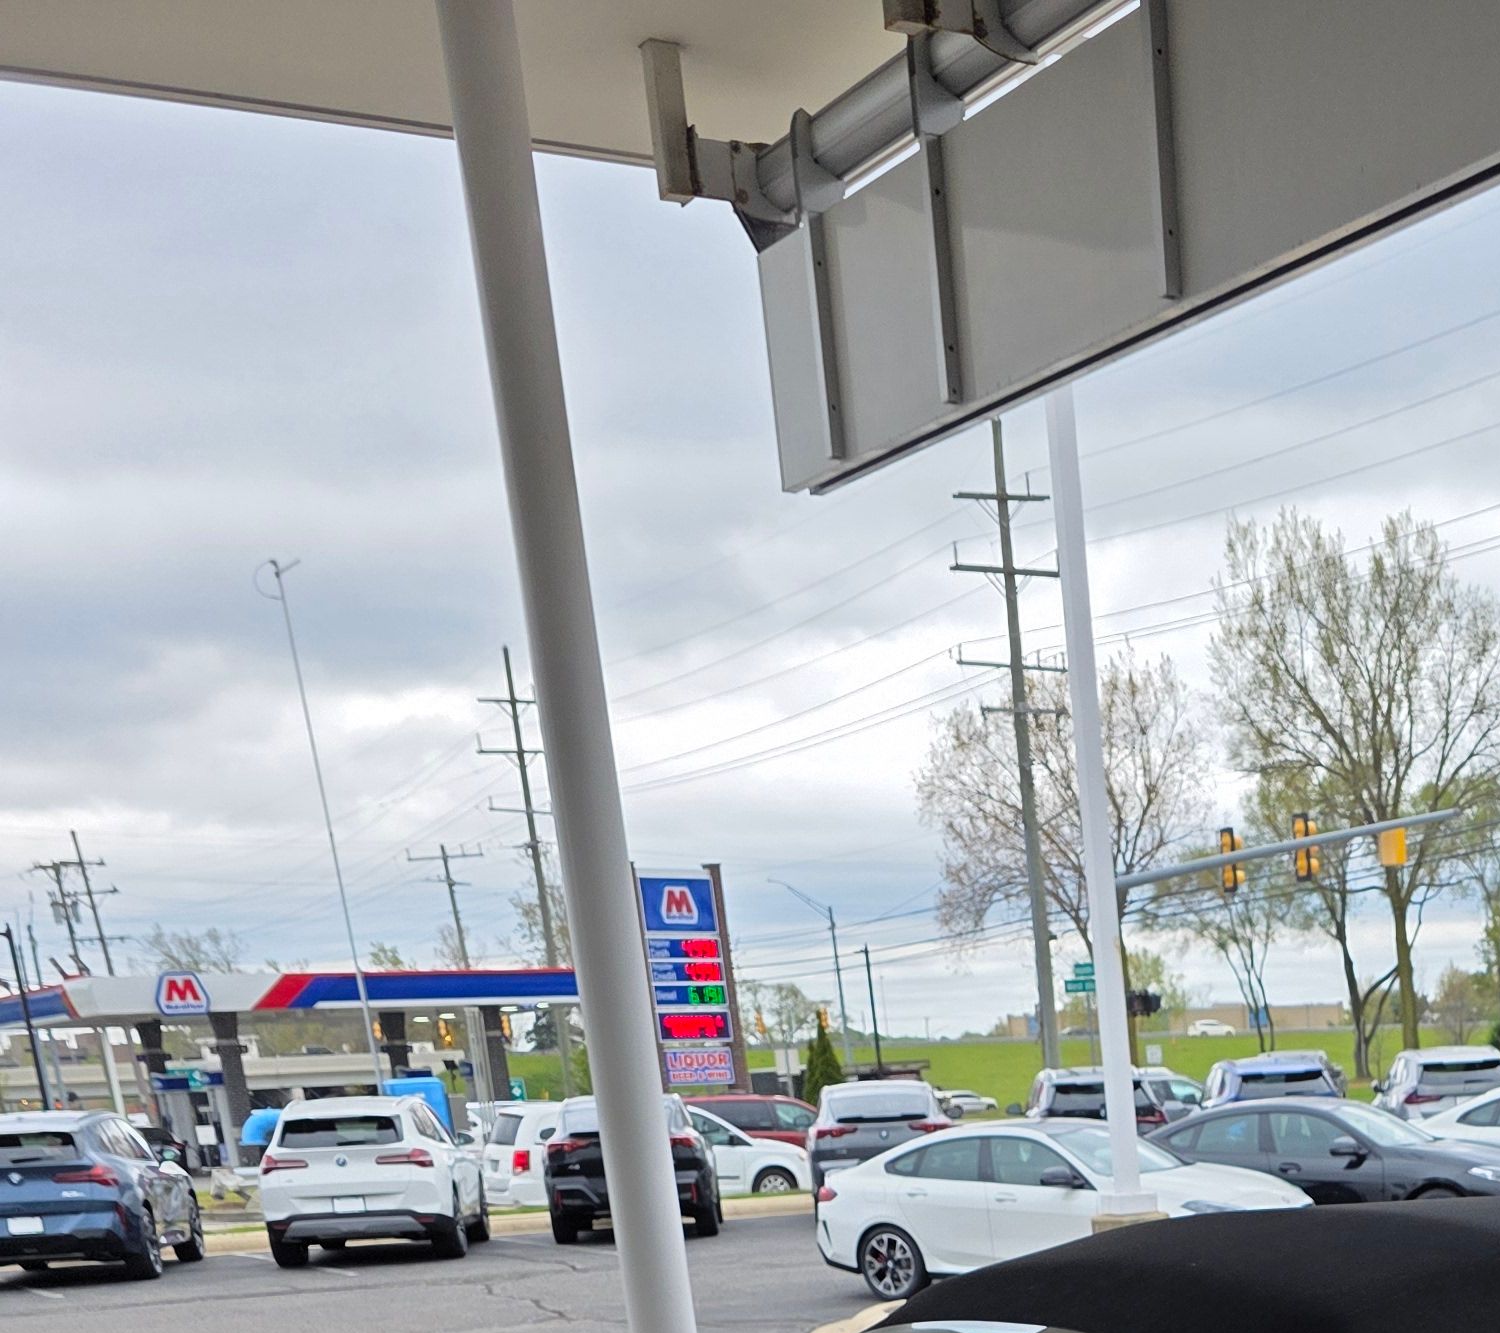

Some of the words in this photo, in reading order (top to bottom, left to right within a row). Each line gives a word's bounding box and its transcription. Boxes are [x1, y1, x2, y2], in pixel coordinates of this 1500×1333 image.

[666, 890, 693, 913] M
[165, 979, 201, 1002] M
[668, 1053, 728, 1069] LIQUOR
